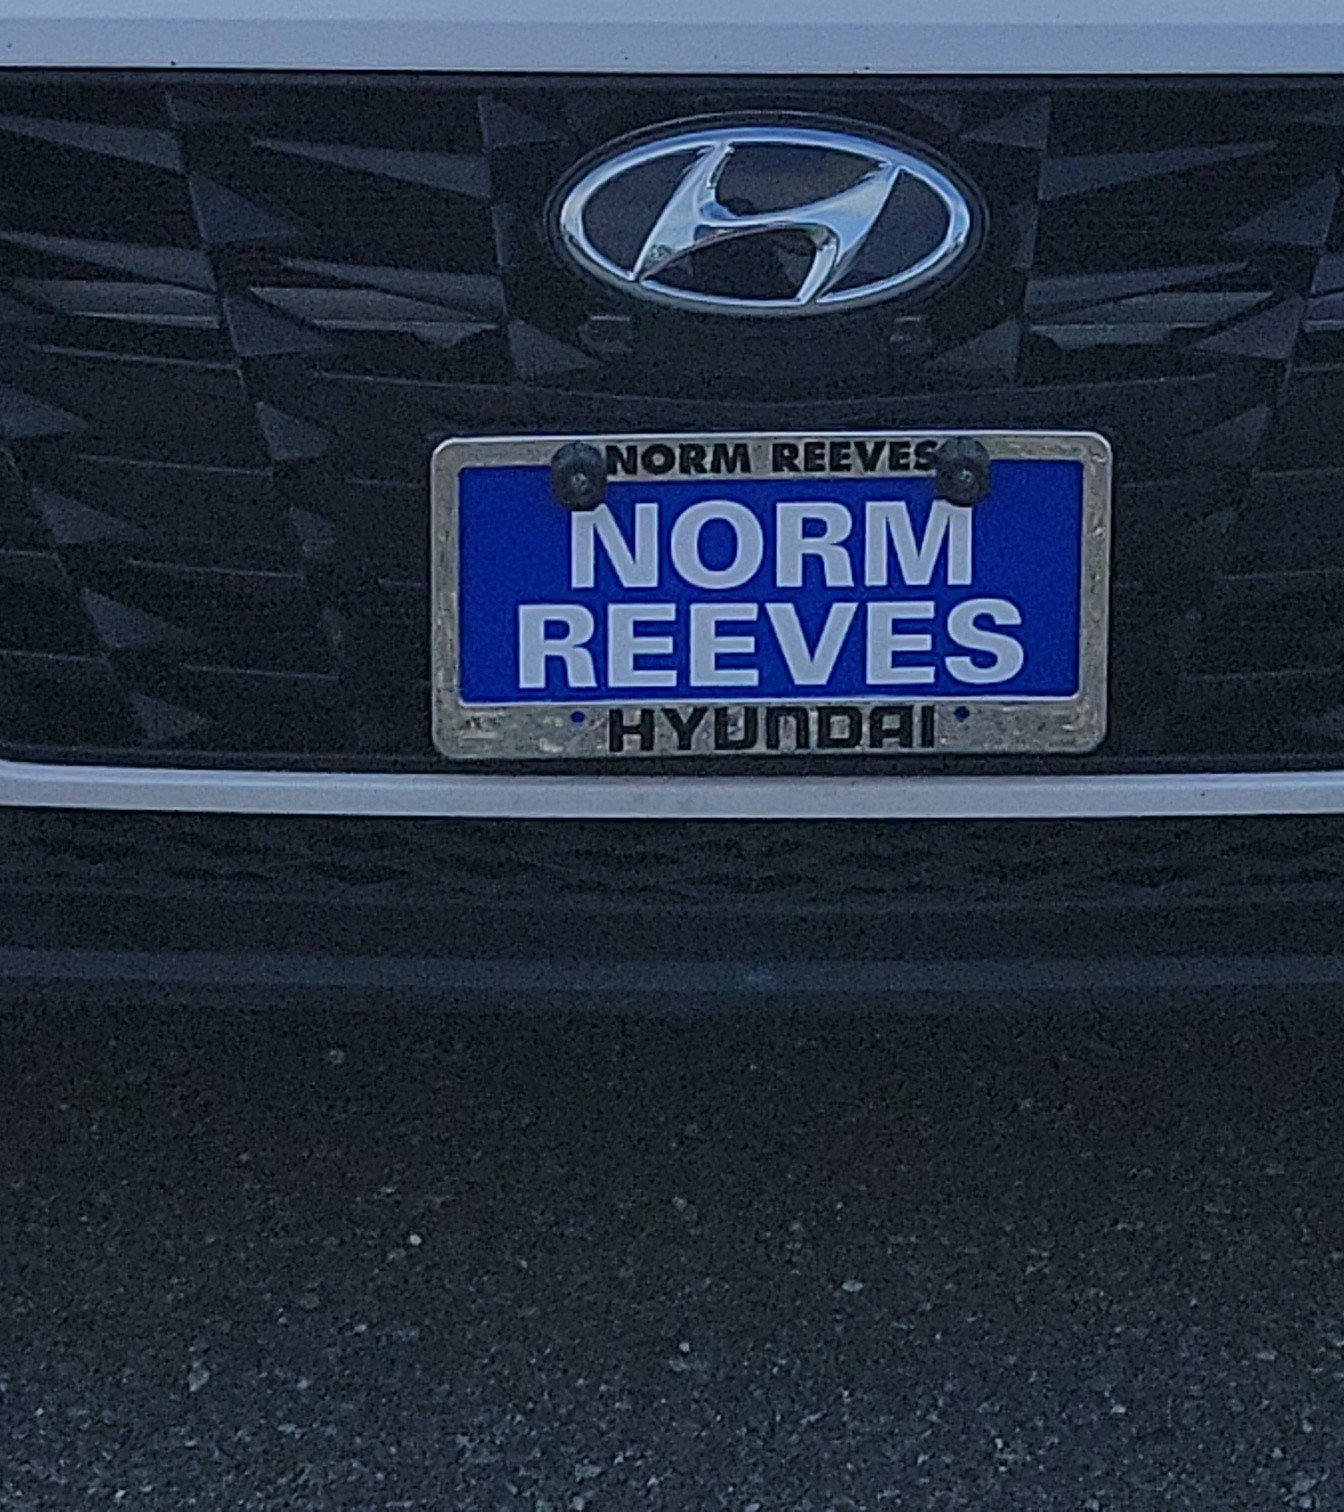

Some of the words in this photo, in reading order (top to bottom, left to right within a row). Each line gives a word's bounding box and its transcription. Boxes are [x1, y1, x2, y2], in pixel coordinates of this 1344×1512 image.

[605, 442, 752, 476] NORM
[771, 439, 940, 473] REEVES
[570, 498, 973, 590] NORM
[517, 597, 1026, 689] REEVES
[608, 704, 936, 753] HYUNDAI
